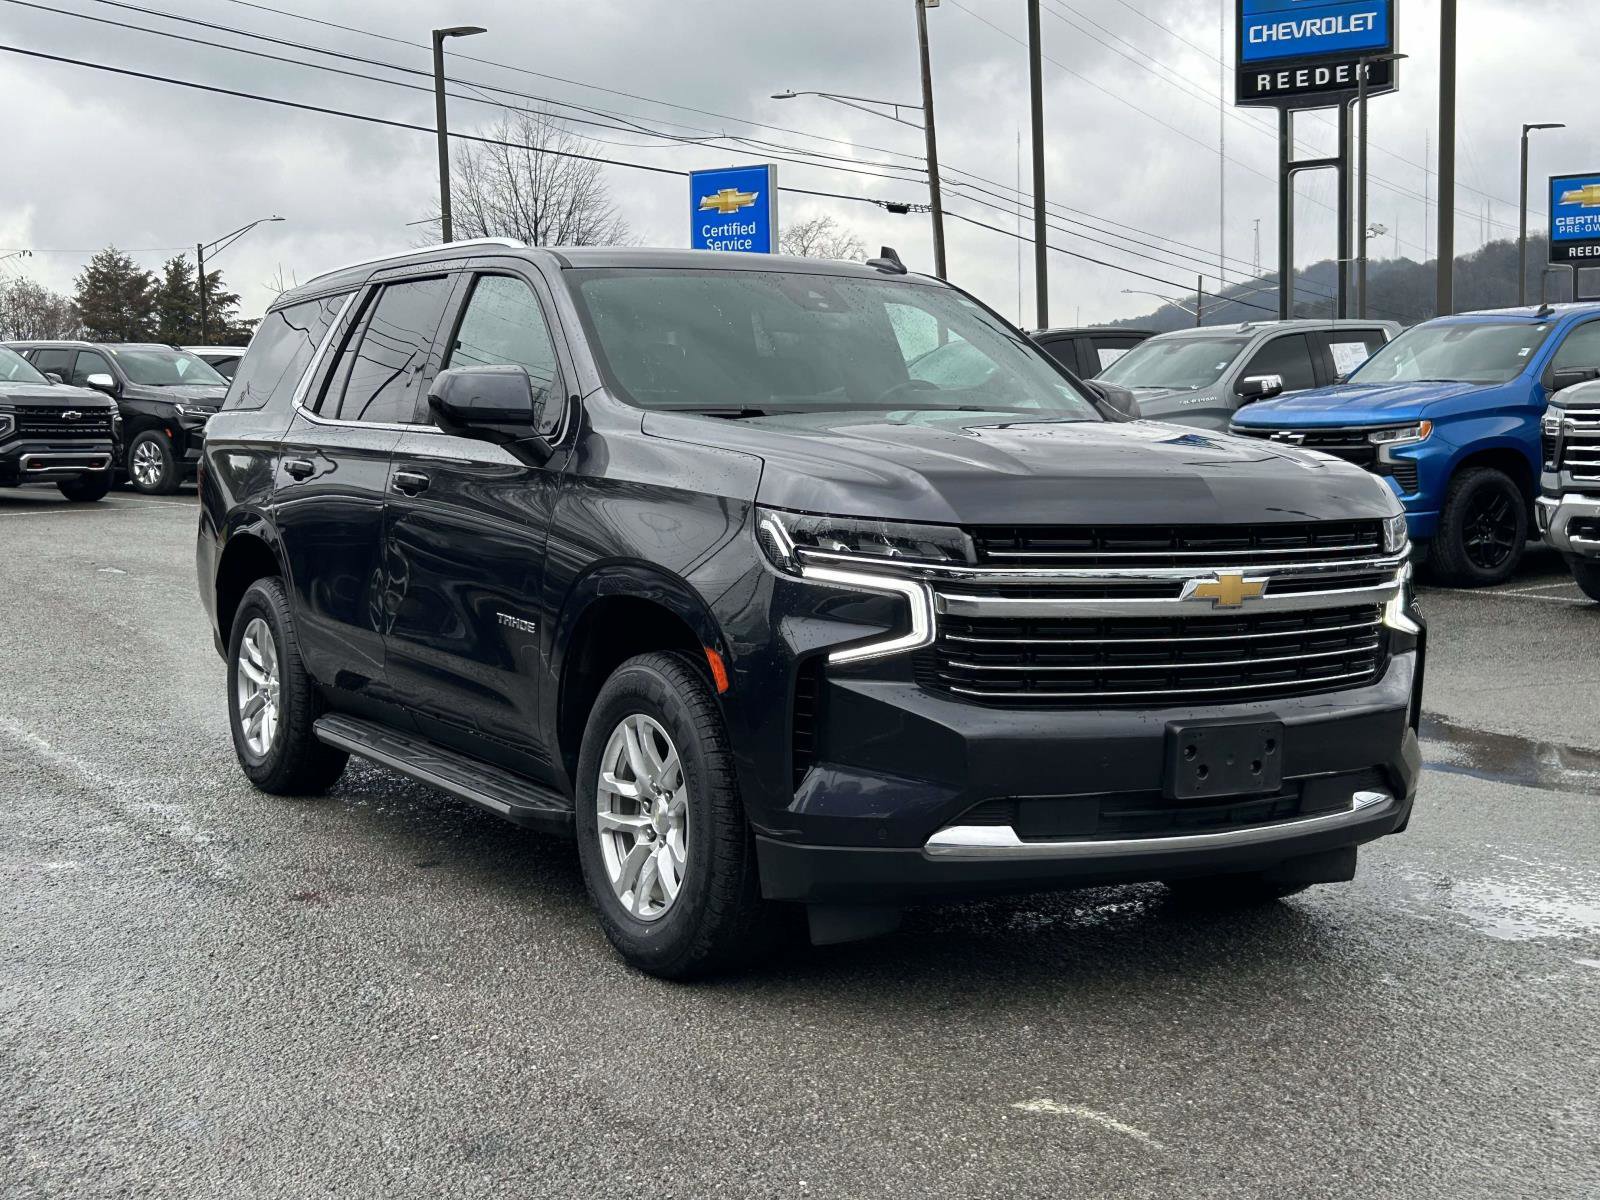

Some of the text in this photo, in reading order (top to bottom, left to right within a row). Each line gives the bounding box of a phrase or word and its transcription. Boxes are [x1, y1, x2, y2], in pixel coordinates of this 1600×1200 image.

[1249, 12, 1377, 43] CHEVROLET
[702, 222, 756, 237] Certified
[706, 237, 752, 251] Service
[496, 612, 536, 633] TAHOE
